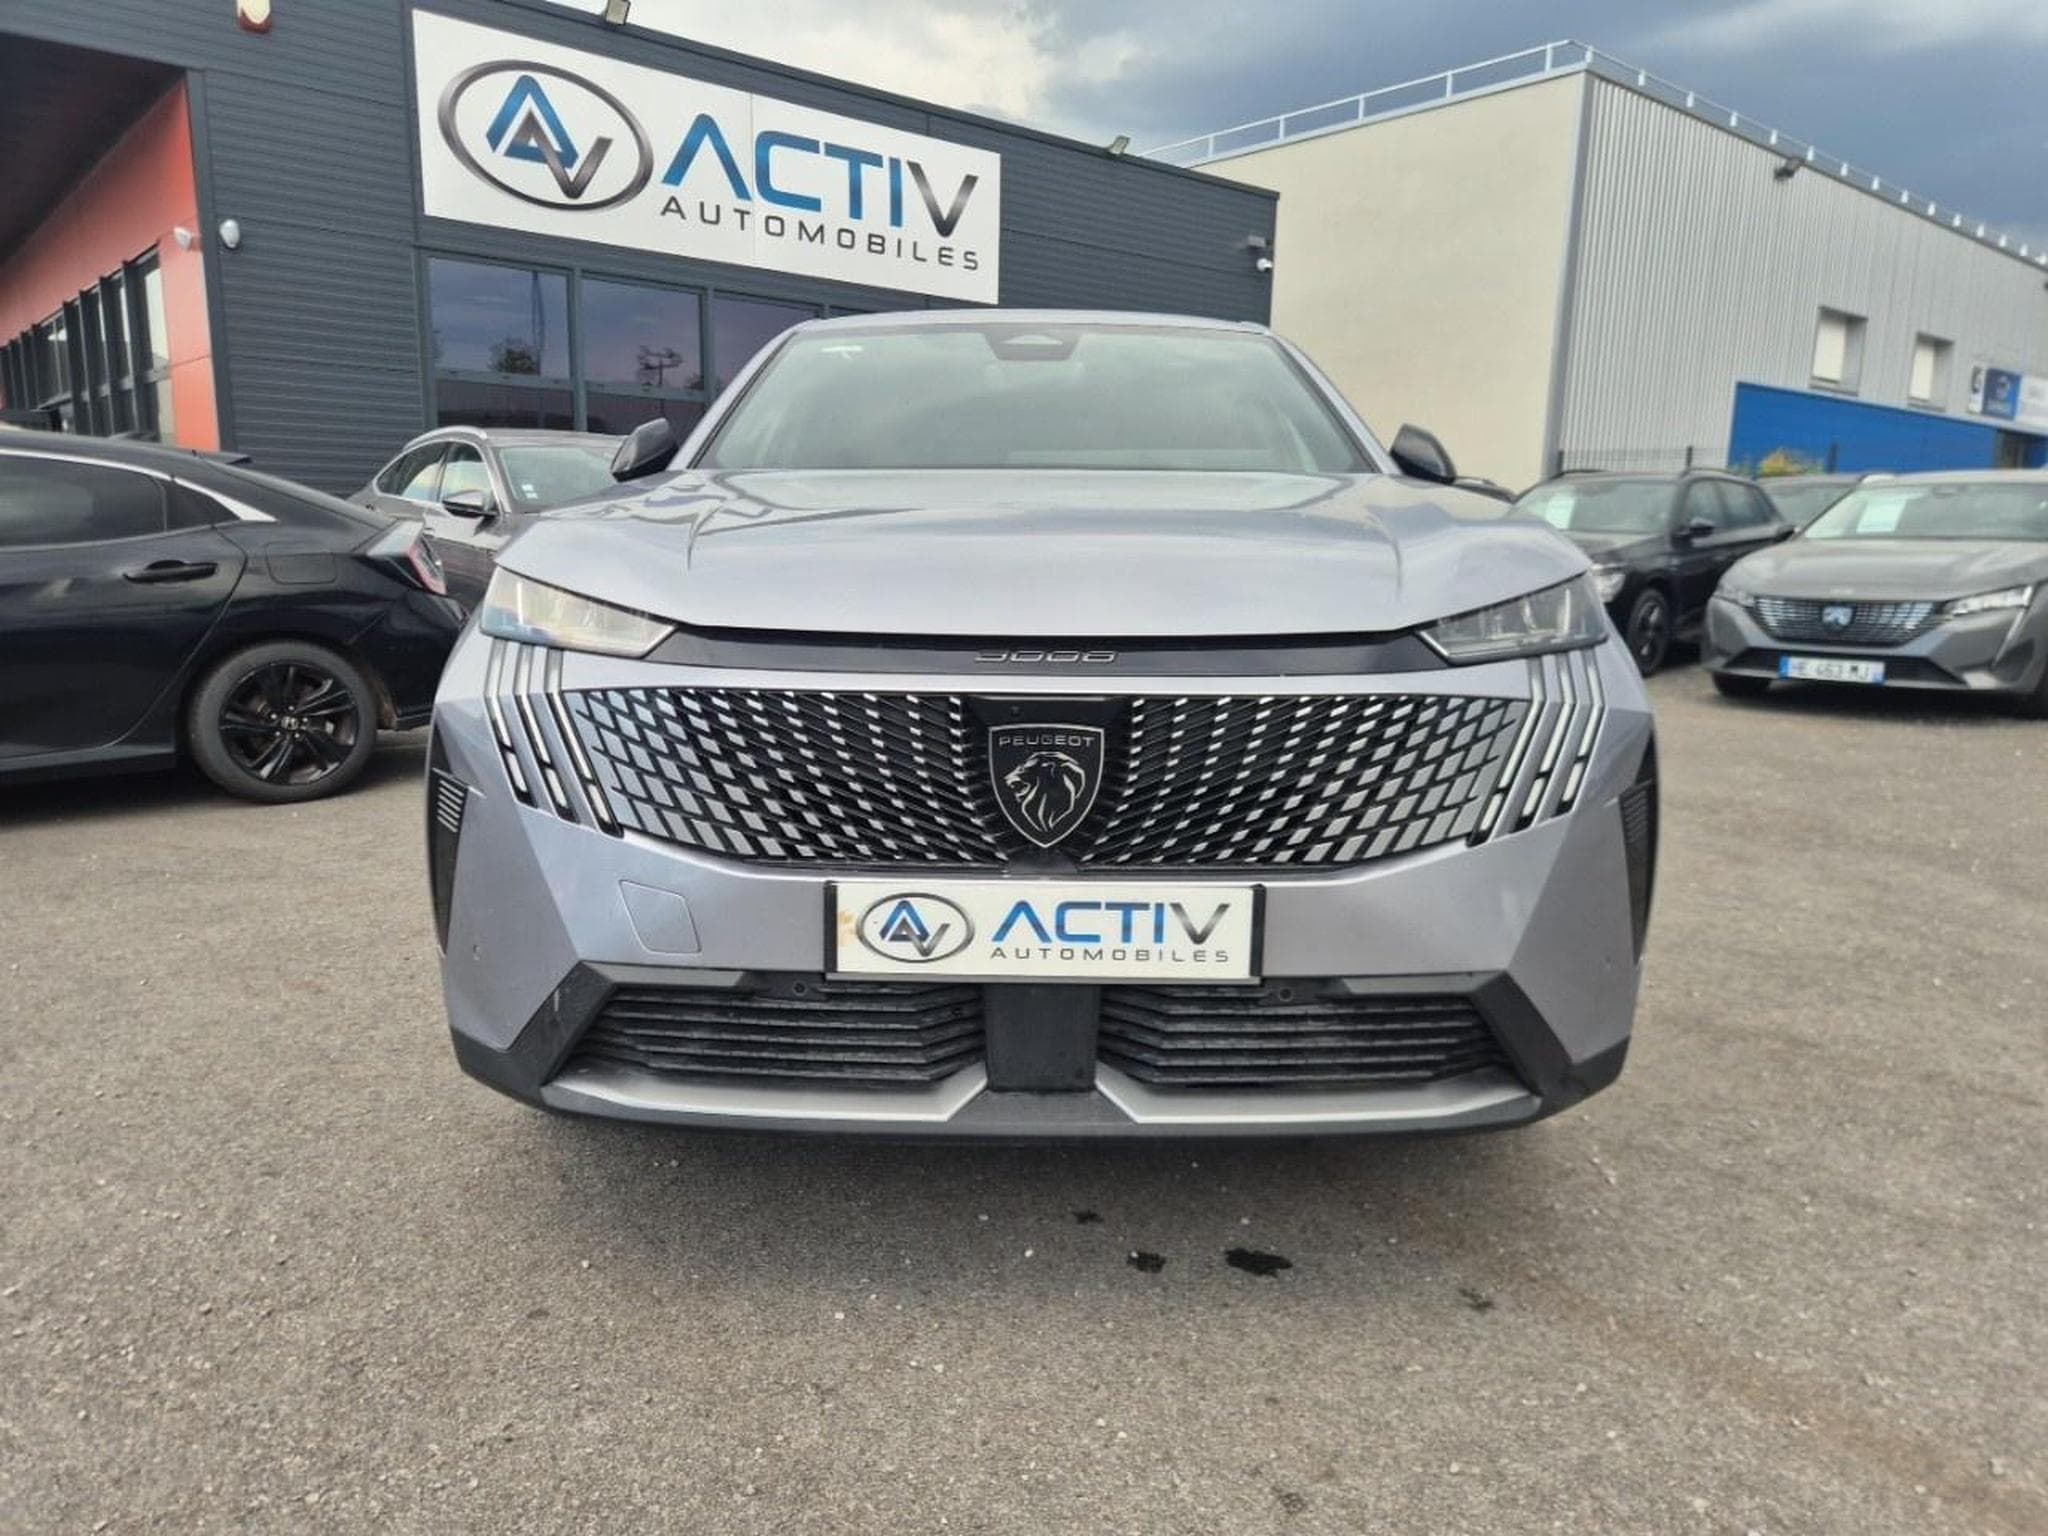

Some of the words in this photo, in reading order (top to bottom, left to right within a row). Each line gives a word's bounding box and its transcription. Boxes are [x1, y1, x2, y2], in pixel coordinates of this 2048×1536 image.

[661, 112, 979, 239] ACTIV
[660, 195, 979, 272] AUTOMOBILES
[998, 735, 1096, 747] PEUGEOT
[991, 899, 1231, 946] ACTIV
[990, 947, 1230, 964] AUTOMOBILES
